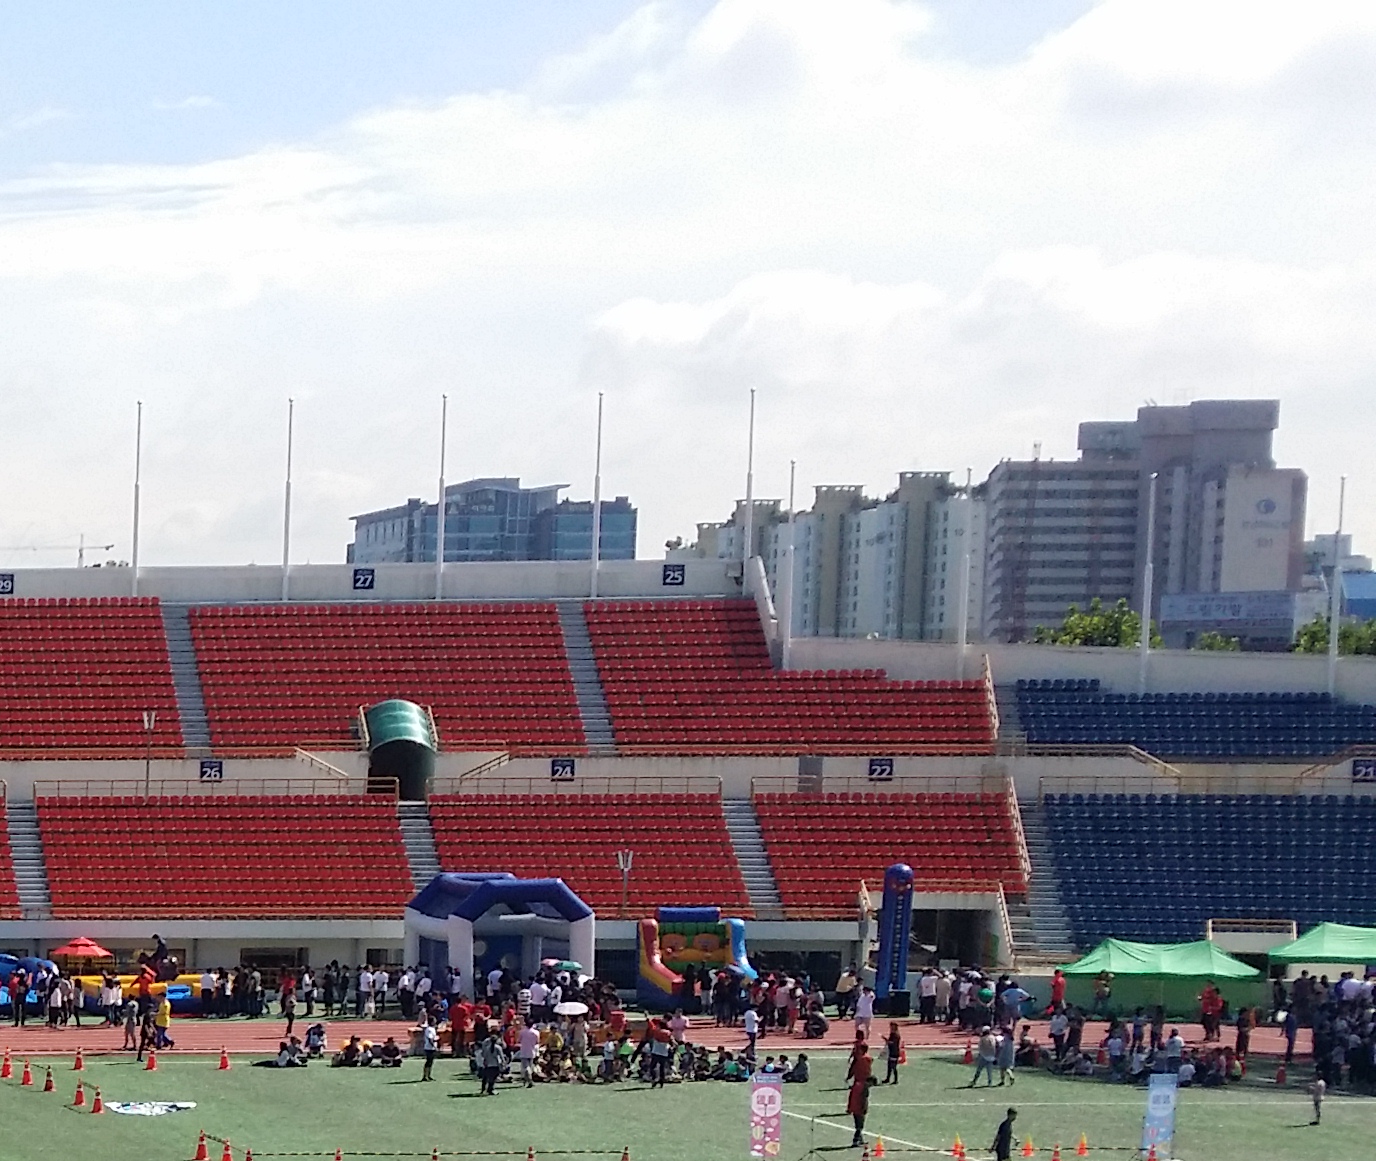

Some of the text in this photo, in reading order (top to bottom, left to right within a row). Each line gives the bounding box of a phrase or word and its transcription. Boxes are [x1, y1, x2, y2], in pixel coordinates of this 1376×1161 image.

[355, 575, 372, 588] 27
[665, 571, 683, 584] 25
[202, 768, 220, 780] 26
[554, 767, 572, 778] 24
[871, 766, 891, 777] 22
